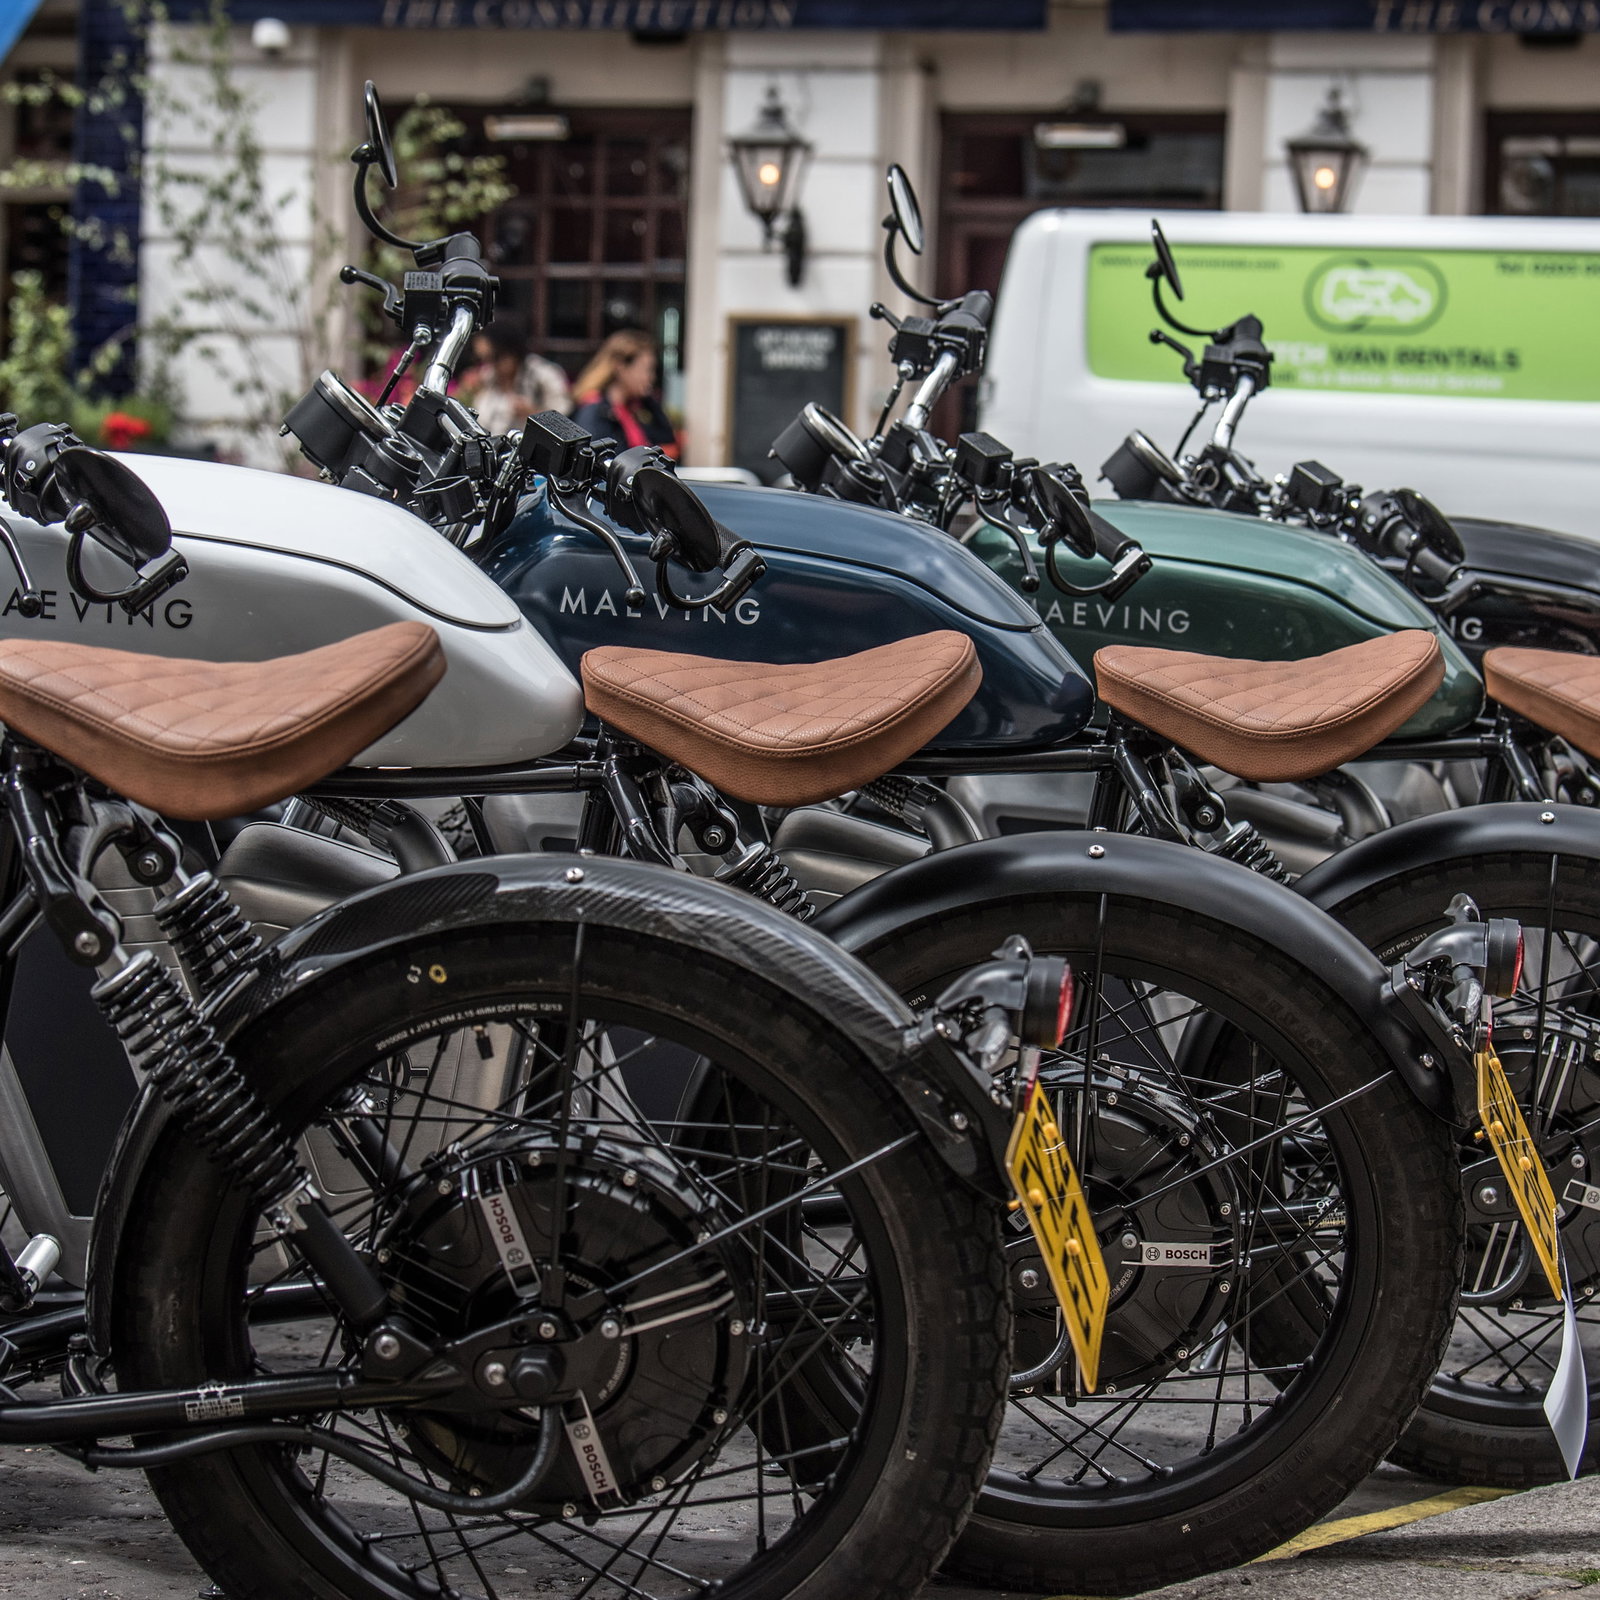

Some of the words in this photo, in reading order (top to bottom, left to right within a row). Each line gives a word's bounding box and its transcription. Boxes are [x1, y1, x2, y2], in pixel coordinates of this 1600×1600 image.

[1331, 344, 1386, 367] VAN
[1395, 345, 1521, 372] RENTALS
[1030, 597, 1190, 634] AEVING
[497, 1004, 516, 1013] DOT
[908, 994, 927, 1007] 12/13
[489, 1198, 515, 1244] BOSCH
[1165, 1249, 1207, 1260] BOSCH
[582, 1444, 609, 1489] BOSCH
